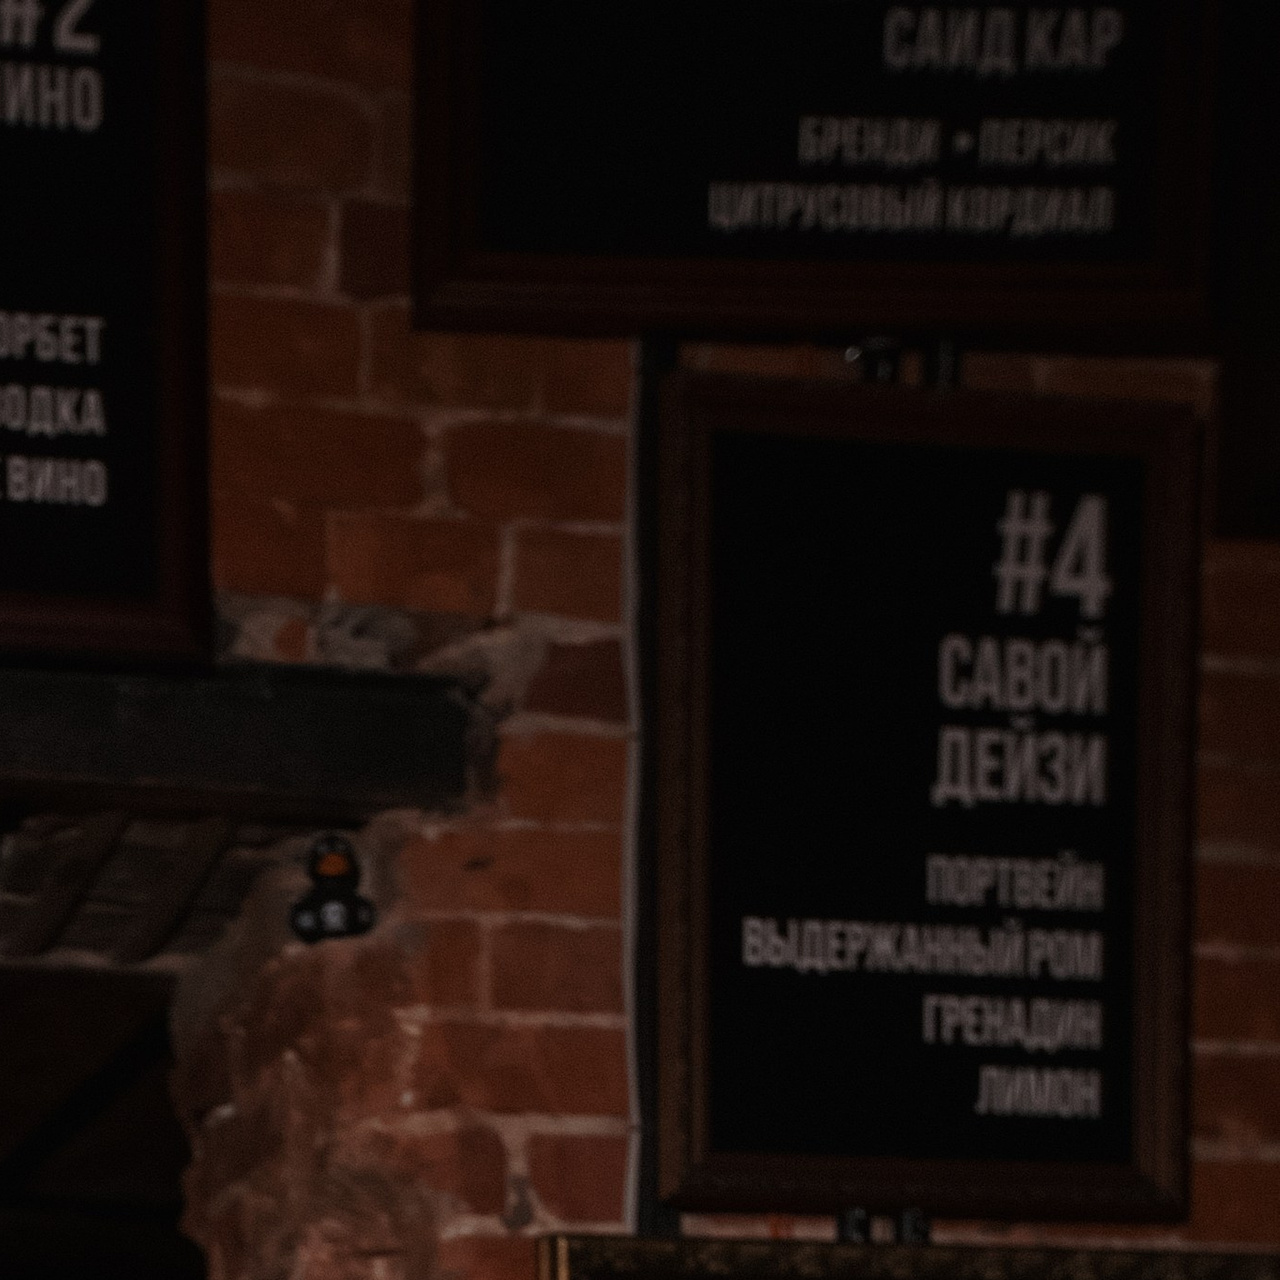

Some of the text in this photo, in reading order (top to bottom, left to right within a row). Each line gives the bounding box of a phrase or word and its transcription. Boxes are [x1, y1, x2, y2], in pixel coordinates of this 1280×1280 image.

[1025, 8, 1122, 70] КАР
[798, 117, 1115, 168] БРЕНДИ ПЕРСИК
[7, 455, 107, 506] ВИНО
[992, 489, 1113, 618] #4
[938, 624, 1108, 715] САВОЙ
[930, 716, 1107, 808] ДЕЙЗИ
[742, 917, 1103, 979] ВЫДЕРЖАННЫЙ РОМ
[923, 994, 1101, 1052] ГРЕНАДИН
[975, 1066, 1100, 1117] ЛИМОН
